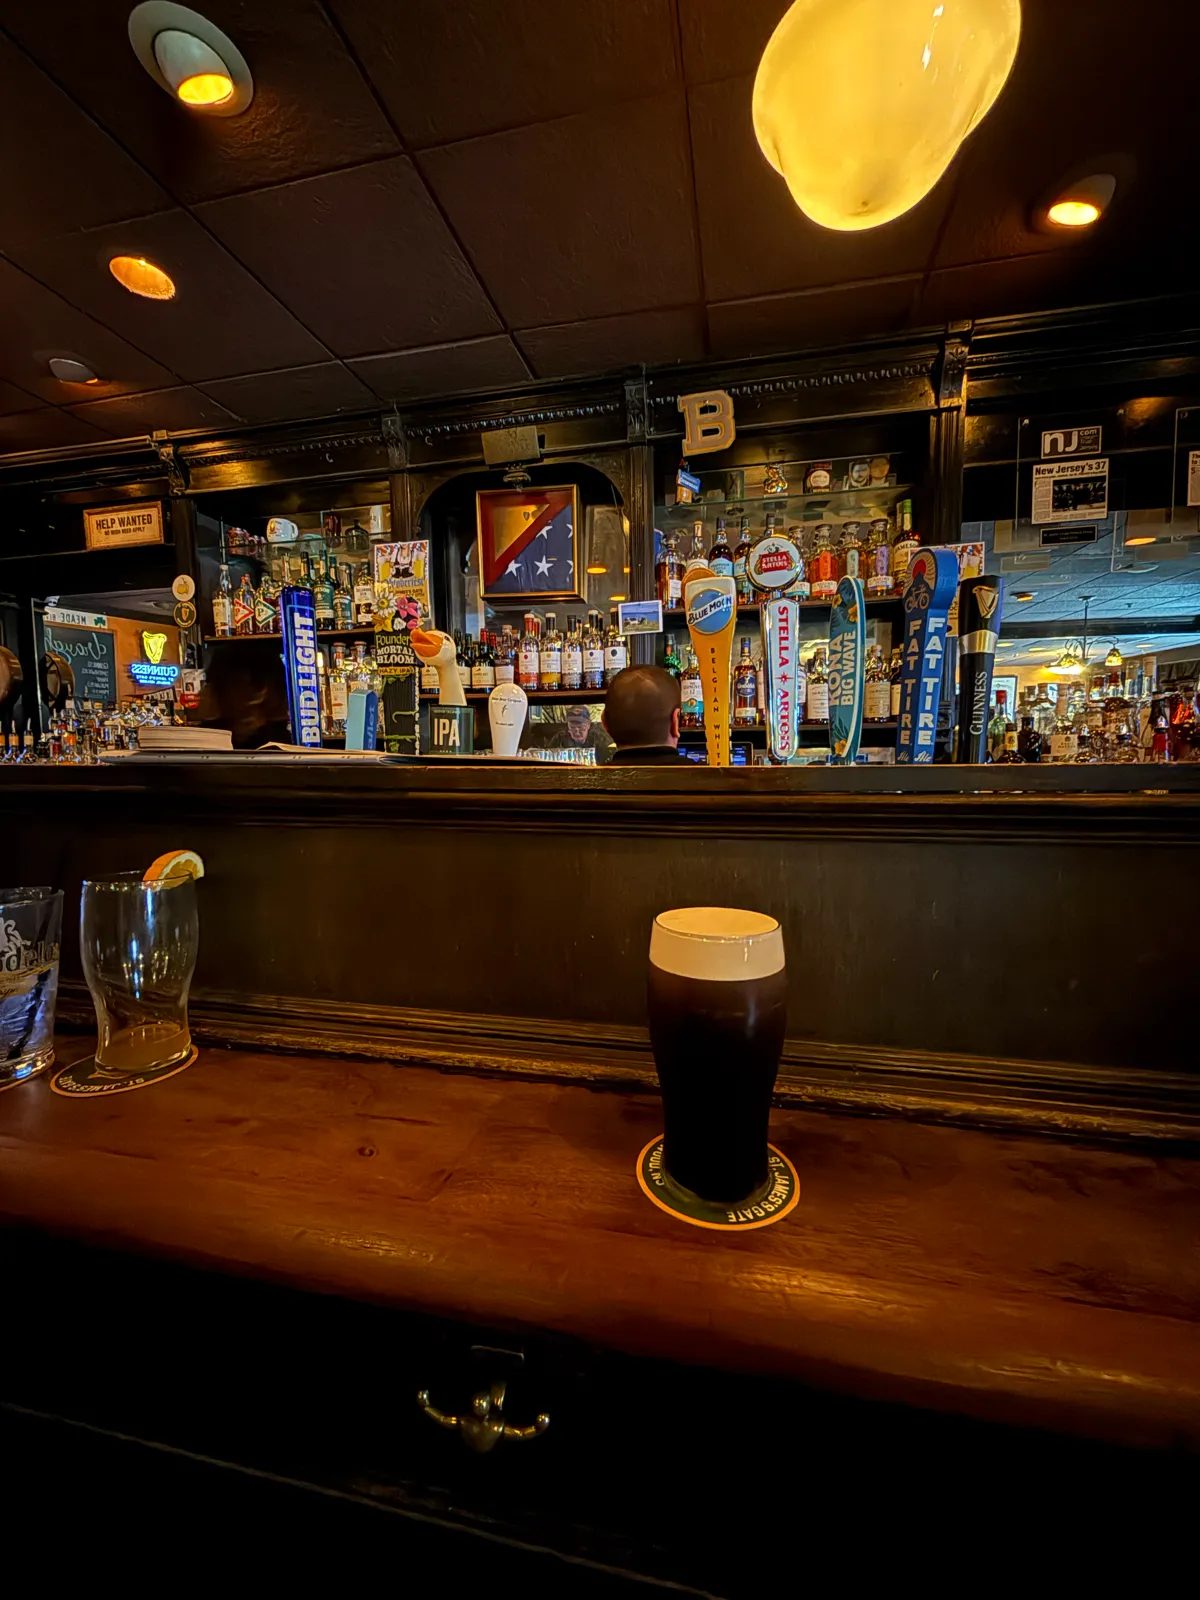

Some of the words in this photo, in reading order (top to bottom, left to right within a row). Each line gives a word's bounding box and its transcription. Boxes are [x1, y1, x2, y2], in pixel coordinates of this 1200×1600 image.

[677, 389, 737, 457] B
[1035, 467, 1054, 476] New
[1056, 462, 1093, 475] Jersey's
[1095, 461, 1107, 470] 37
[96, 518, 116, 530] HELP
[118, 513, 153, 528] WANTED
[762, 555, 787, 564] STELLA
[688, 607, 709, 625] BLUE
[777, 606, 790, 669] STELLA
[293, 612, 317, 687] LIGHT
[376, 634, 411, 649] Founder
[377, 645, 415, 657] MORTAL
[377, 654, 415, 664] BLOOM
[841, 630, 856, 677] WAVE
[906, 619, 923, 671] FAT
[924, 617, 946, 669] FAT
[380, 667, 397, 675] HAZY
[710, 647, 720, 713] BELGIAN
[828, 633, 843, 706] KONA
[840, 678, 855, 706] BIG
[299, 690, 321, 743] BUD
[777, 688, 791, 751] ARTOIS
[900, 678, 917, 745] TIRE
[917, 677, 940, 746] TIRE
[969, 671, 988, 735] GUINNESS
[433, 718, 461, 747] IPA
[726, 1206, 766, 1223] GATE
[761, 1171, 790, 1213] JAMES'S
